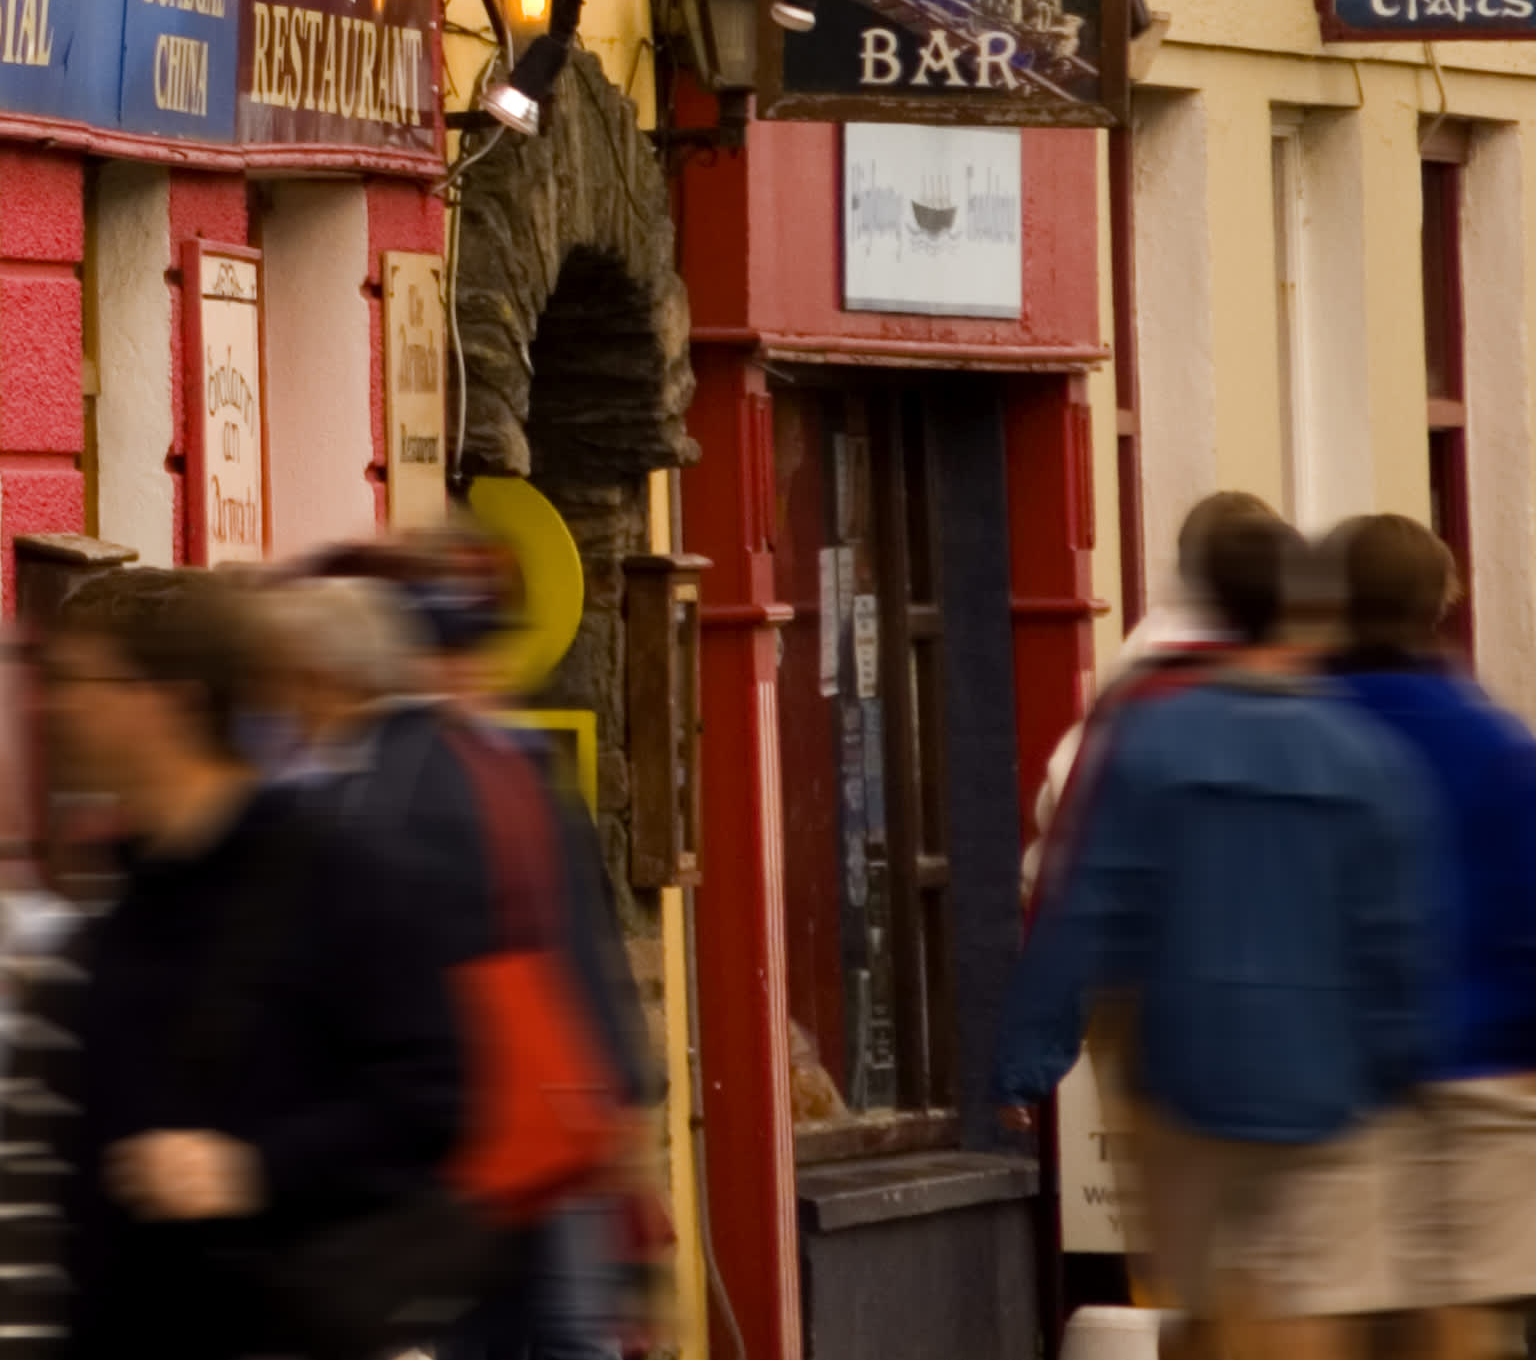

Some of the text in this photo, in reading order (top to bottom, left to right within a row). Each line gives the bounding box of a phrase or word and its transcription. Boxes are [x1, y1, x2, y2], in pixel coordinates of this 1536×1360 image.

[154, 34, 210, 117] CHINA
[251, 1, 423, 126] RESTAURANT
[858, 27, 1022, 90] BAR
